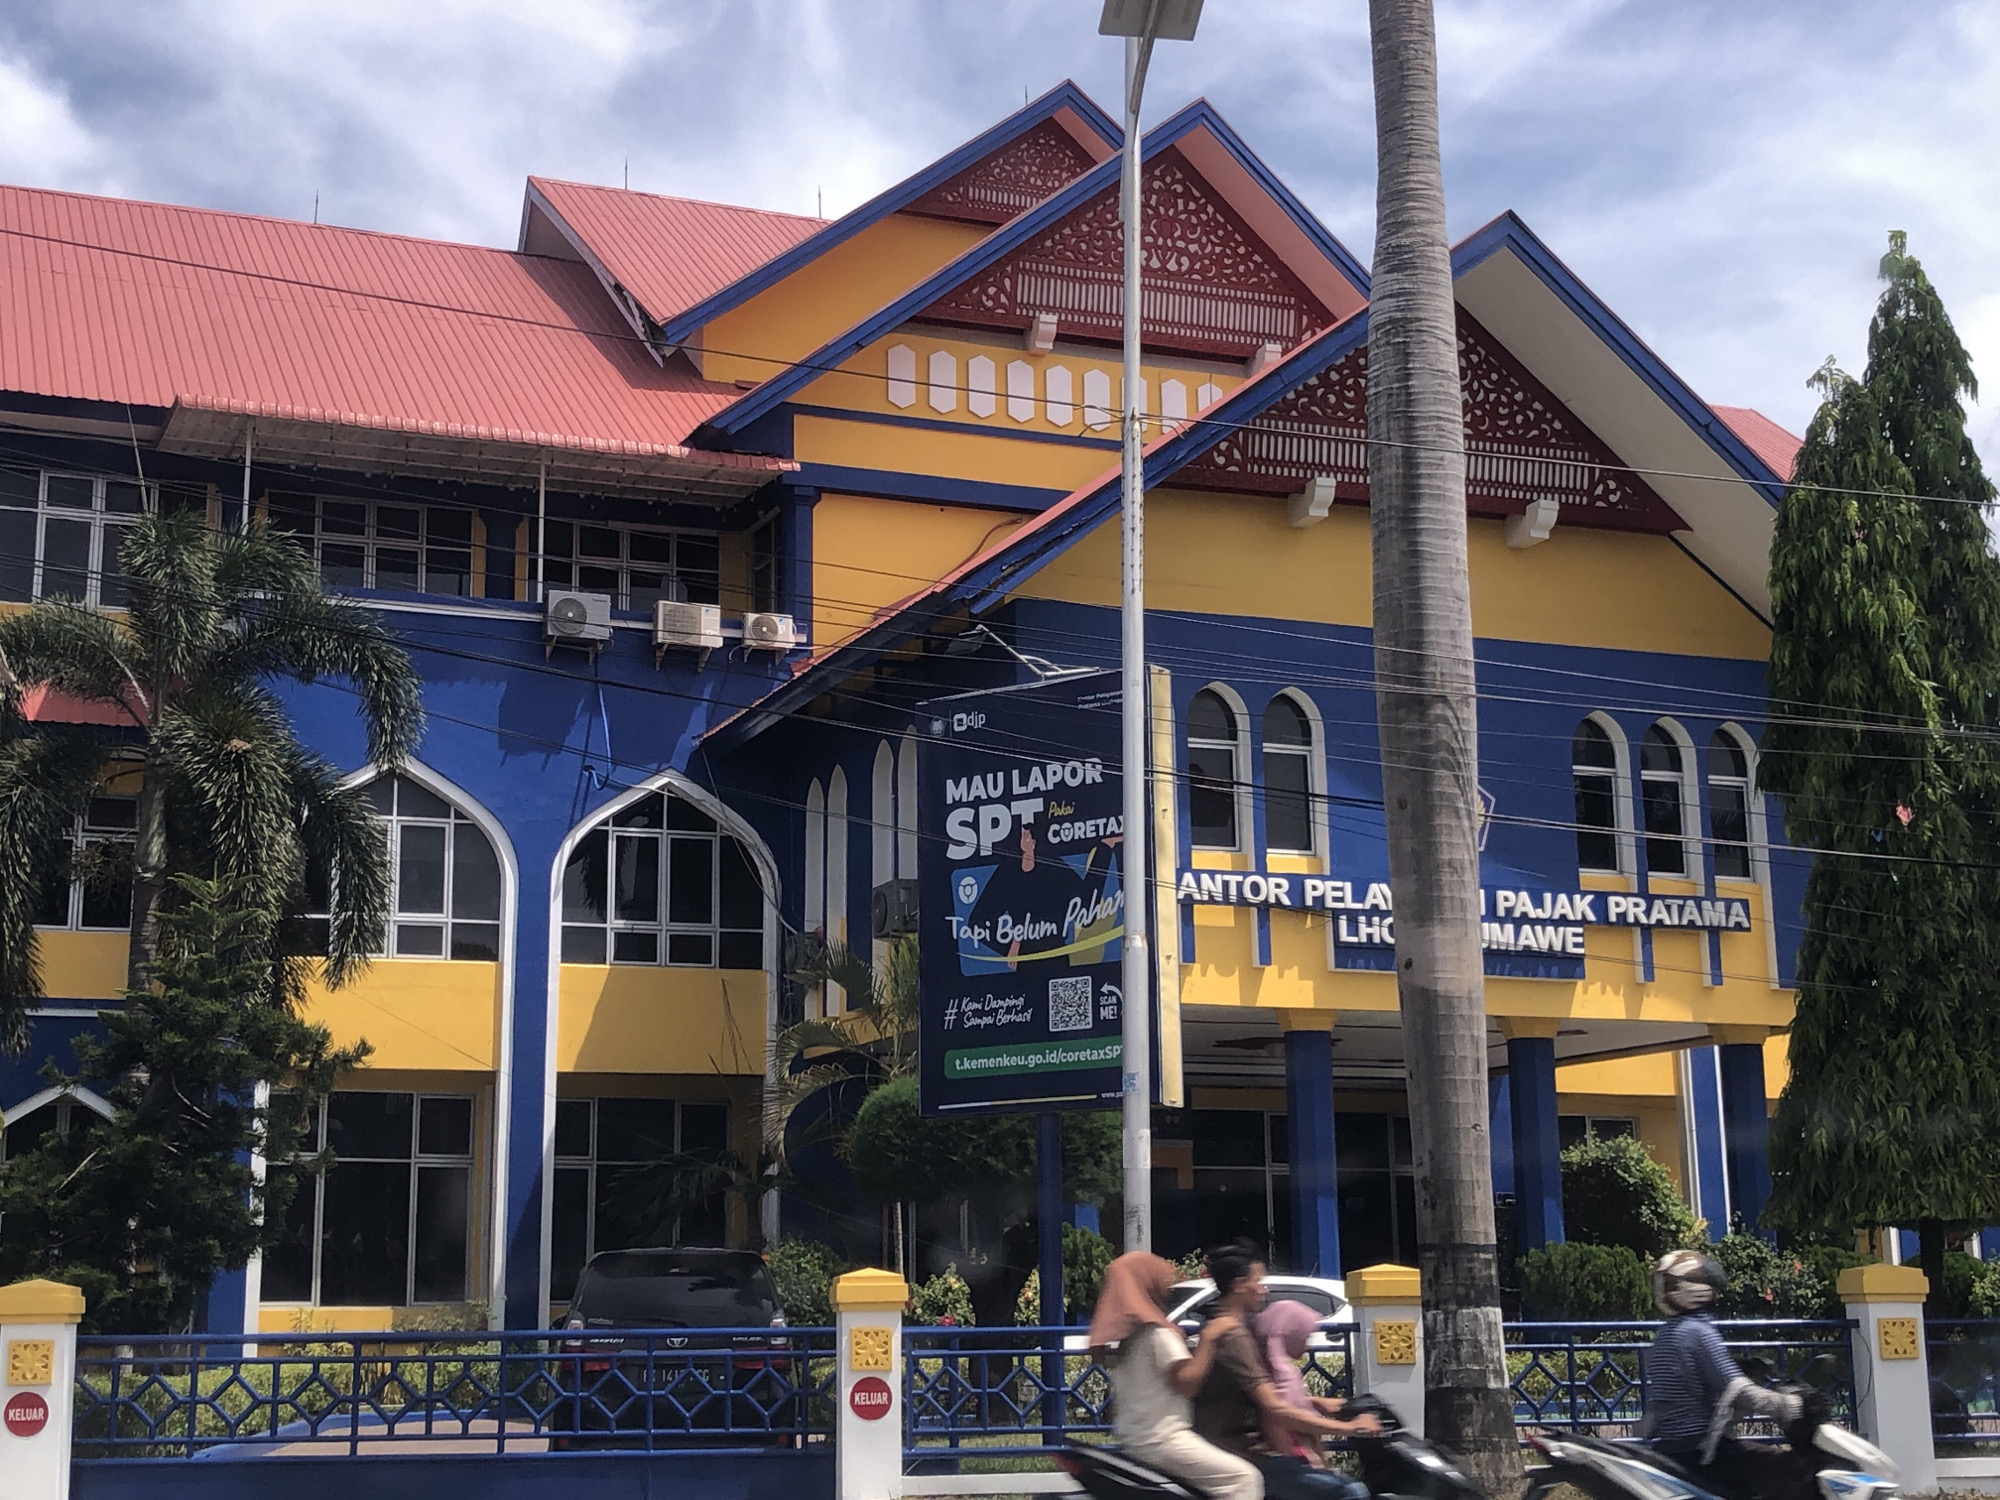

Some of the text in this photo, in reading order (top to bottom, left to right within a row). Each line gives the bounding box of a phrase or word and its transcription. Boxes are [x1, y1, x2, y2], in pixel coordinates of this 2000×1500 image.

[946, 757, 1103, 804] MAU LAPOR
[1048, 801, 1075, 819] Pakai
[945, 797, 1044, 860] SPT
[1176, 872, 1292, 906] ANTOR
[1496, 890, 1597, 923] PAJAK
[1607, 896, 1751, 929] PRATAMA
[944, 916, 991, 949] Tapi
[996, 912, 1058, 944] Belum
[960, 996, 983, 1013] Kami
[984, 993, 1026, 1012] Dampingi
[1099, 995, 1117, 1006] SCAN
[963, 1007, 1034, 1030] Sampai Berhasil
[1100, 1005, 1118, 1021] ME!
[954, 1044, 1123, 1071] t.kemenkeu.go.id/coretaxSP
[854, 1391, 889, 1406] KELUAR
[8, 1407, 45, 1422] KELUAR
